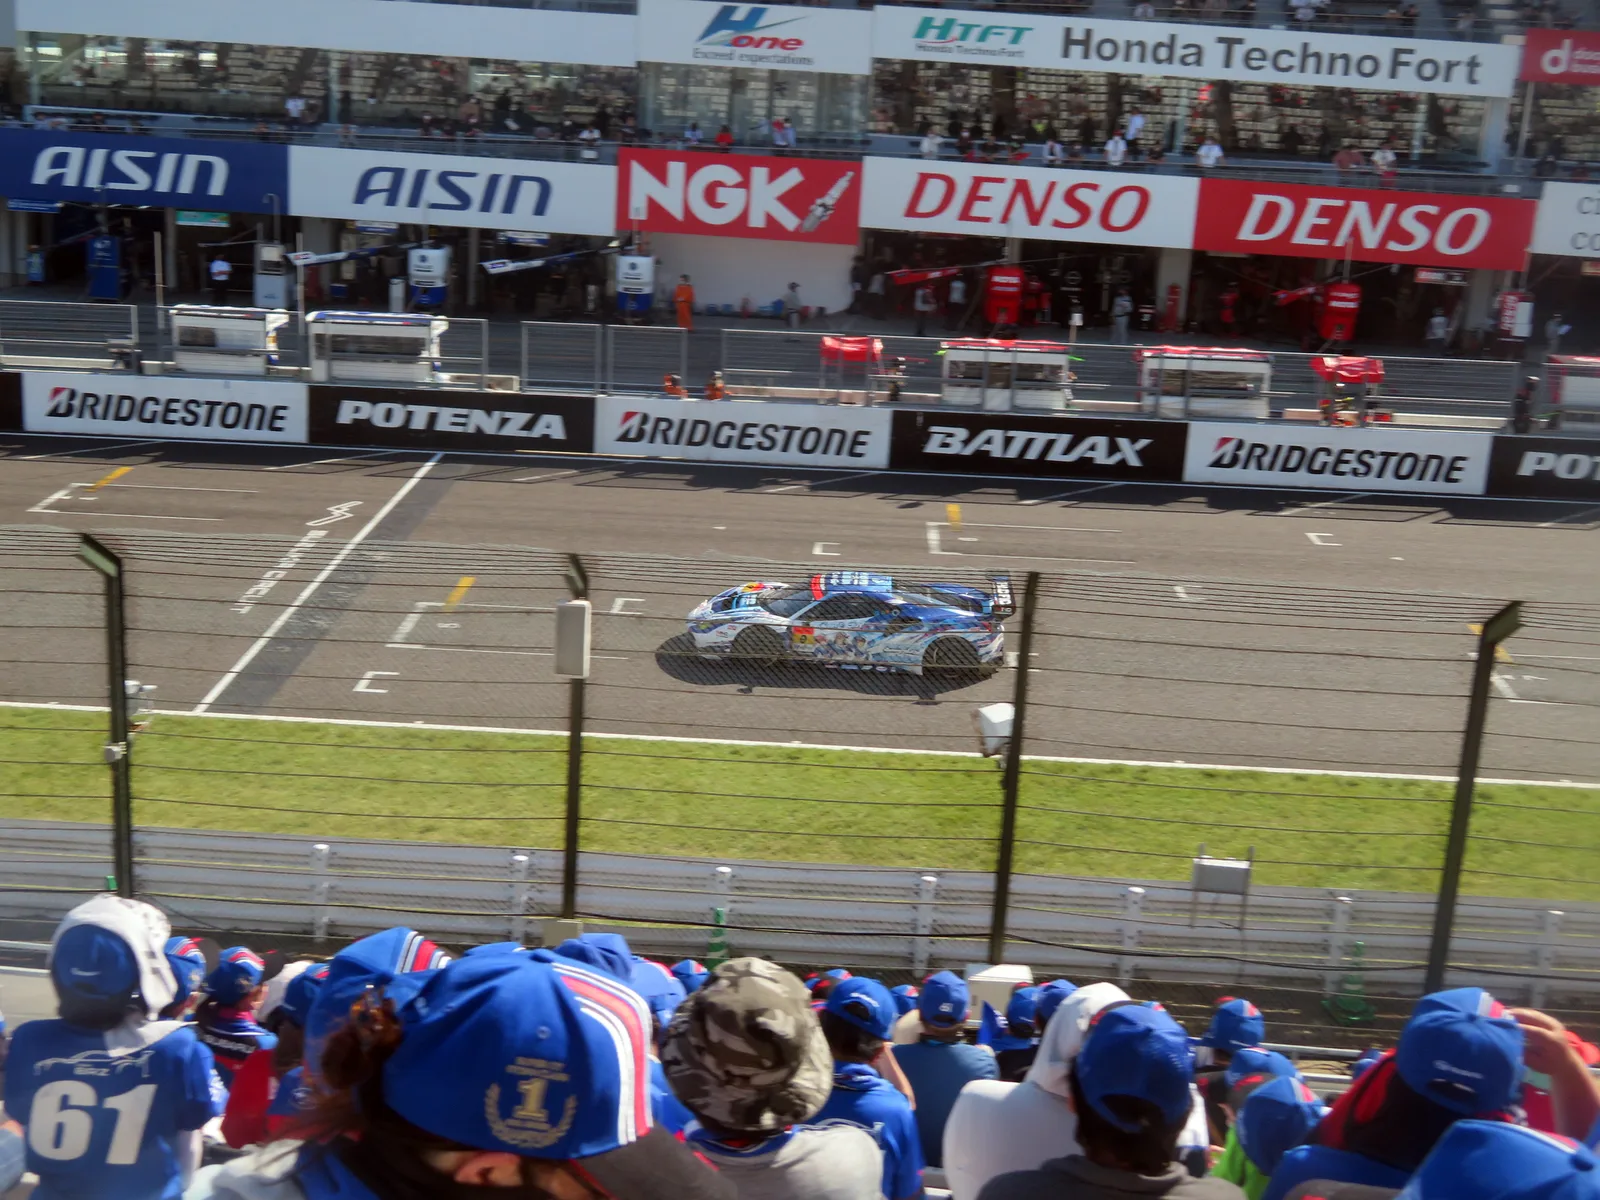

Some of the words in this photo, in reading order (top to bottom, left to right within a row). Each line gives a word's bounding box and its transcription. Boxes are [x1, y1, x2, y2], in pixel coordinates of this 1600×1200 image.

[912, 16, 1035, 45] HTFT
[692, 48, 735, 60] Exceed
[738, 53, 815, 66] expectations
[1061, 27, 1203, 67] Honda
[1217, 36, 1380, 80] Techno
[1389, 47, 1482, 85] Fort
[31, 146, 229, 196] AISIN
[354, 166, 552, 217] AISIN
[629, 159, 804, 232] NGK
[904, 172, 1152, 233] DENSO
[1236, 192, 1493, 256] DENSO
[46, 387, 290, 432] BRIDGESTONE
[336, 400, 567, 440] POTENZA
[615, 411, 873, 458] BRIDGESTONE
[922, 425, 1154, 467] BATTLAX
[1208, 436, 1469, 484] BRIDGESTONE
[28, 1080, 158, 1165] 61
